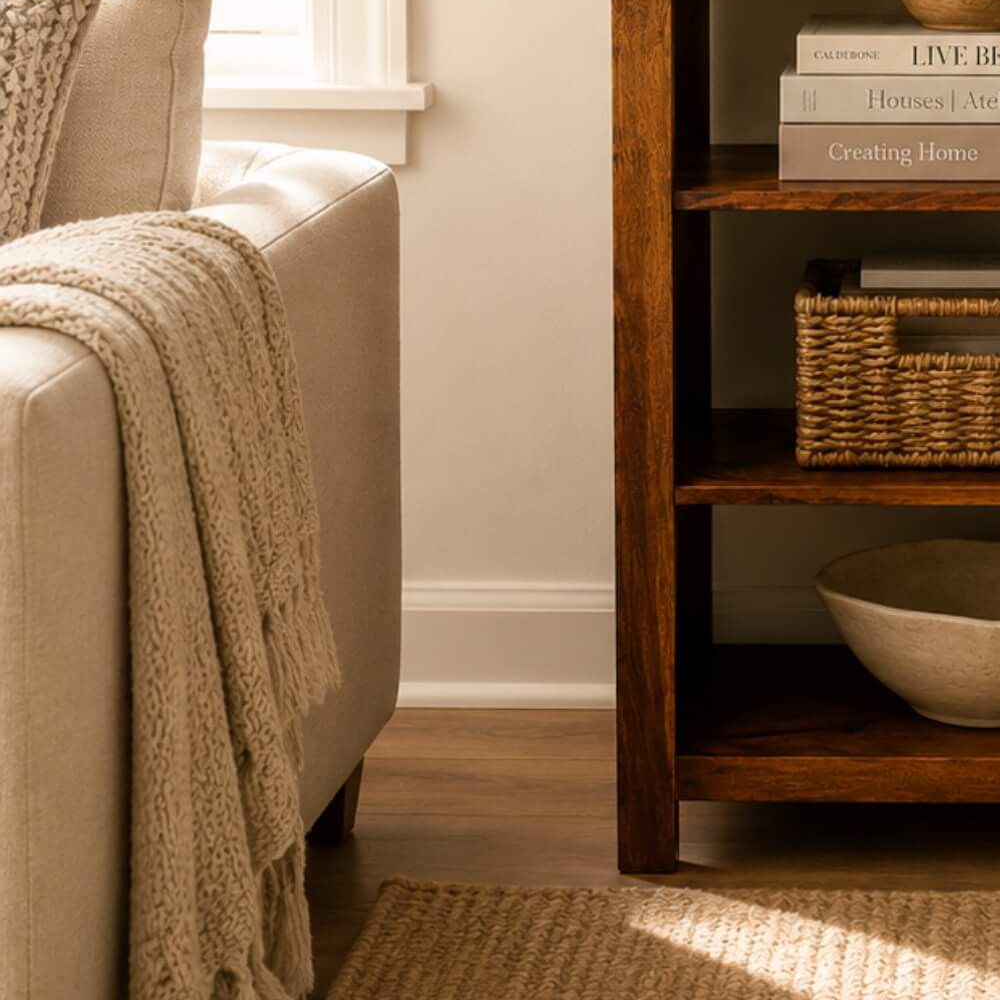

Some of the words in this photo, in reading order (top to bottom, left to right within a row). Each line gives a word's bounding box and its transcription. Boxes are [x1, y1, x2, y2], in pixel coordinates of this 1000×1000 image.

[912, 45, 968, 67] LIVE
[867, 88, 945, 110] Houses
[828, 142, 913, 168] Creating
[918, 142, 979, 162] Home
